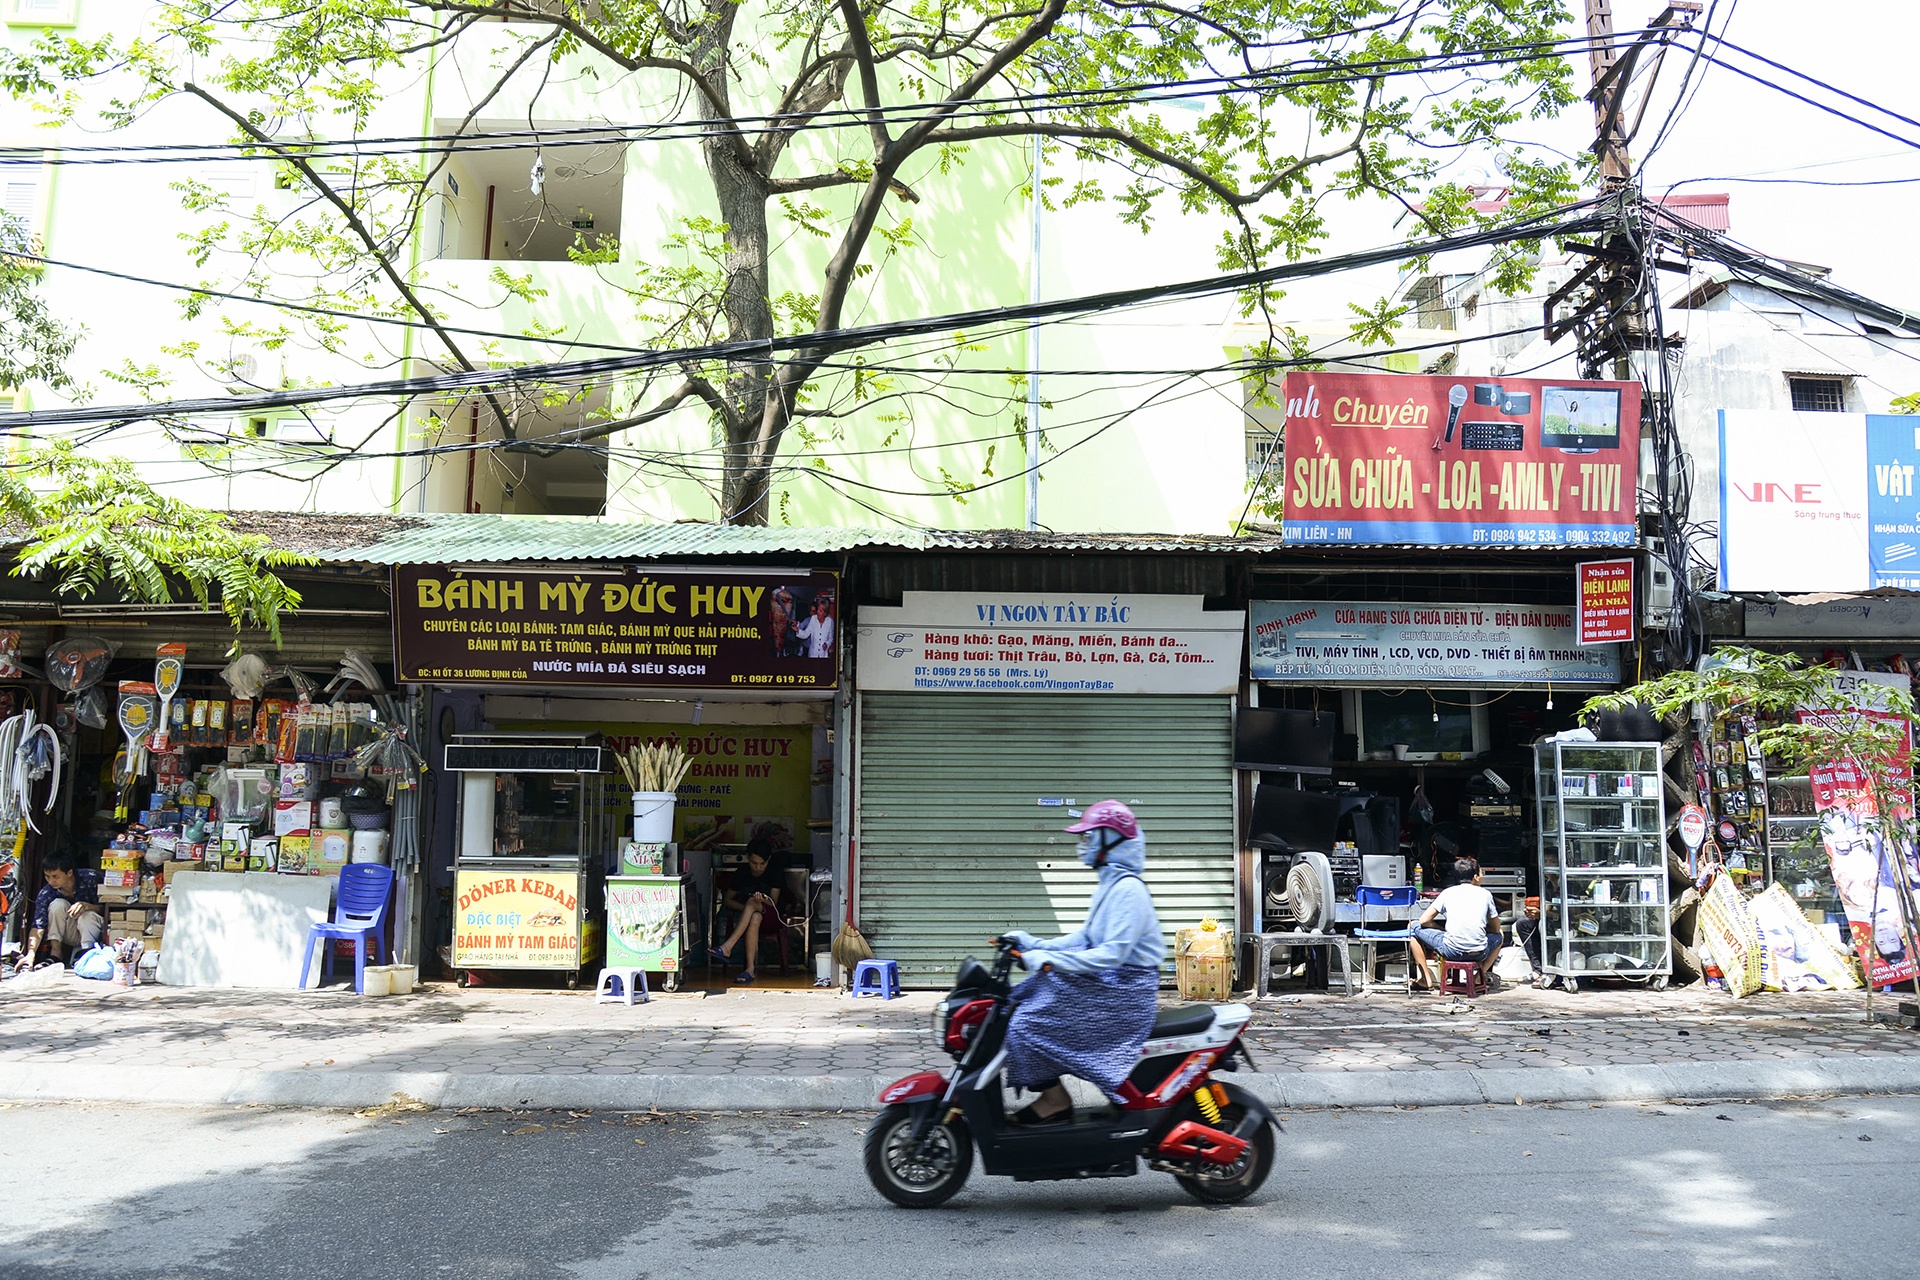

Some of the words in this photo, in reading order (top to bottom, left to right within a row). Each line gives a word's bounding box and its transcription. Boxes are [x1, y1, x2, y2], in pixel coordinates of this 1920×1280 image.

[1333, 396, 1428, 430] Chuyên
[1293, 436, 1342, 508] SỬA
[1350, 446, 1414, 509] CHỮA
[1438, 460, 1482, 510] LOA
[1875, 458, 1914, 503] VẬT
[1304, 525, 1328, 540] LIÊN
[1337, 527, 1352, 540] HN
[1473, 530, 1488, 541] ĐT:
[1491, 530, 1515, 542] 0984
[1517, 530, 1536, 542] 942
[1538, 530, 1556, 542] 534
[1566, 530, 1590, 542] 0904
[1592, 530, 1610, 543] 332
[1612, 531, 1631, 543] 492
[1874, 524, 1895, 535] NHẬN
[1898, 523, 1915, 533] SỬA
[1588, 568, 1609, 578] Nhận
[1612, 567, 1625, 576] sửa
[417, 572, 524, 613] BÁNH
[539, 576, 591, 615] MỲ
[601, 577, 677, 614] ĐỨC
[690, 585, 766, 618] HUY
[1583, 578, 1605, 596] ĐIỆN
[1606, 579, 1630, 595] LẠNH
[1584, 598, 1603, 608] TẠI
[1606, 596, 1628, 605] NHÀ
[976, 605, 995, 626] VỊ
[1000, 605, 1048, 622] NGON
[1053, 601, 1090, 623] TÂY
[1095, 596, 1131, 623] BẮC
[1359, 608, 1387, 624] HÀNG
[1444, 610, 1468, 628] ĐIỆN
[1470, 606, 1484, 625] TỬ
[1495, 610, 1518, 630] ĐIỆN
[1521, 611, 1542, 627] DÂN
[1545, 613, 1571, 630] DỤNG
[1617, 608, 1630, 618] LẠNH
[1829, 606, 1871, 619] ALCOREST
[423, 618, 467, 632] CHUYÊN
[470, 620, 493, 633] CÁC
[495, 621, 520, 636] LOẠI
[523, 620, 557, 634] BÁNH:
[560, 624, 584, 635] TAM
[587, 623, 617, 637] GIÁC,
[620, 623, 650, 637] BÁNH
[653, 624, 671, 637] MỲ
[673, 626, 695, 638] QUE
[698, 621, 717, 638] HẢI
[720, 626, 761, 640] PHÒNG,
[1256, 618, 1284, 635] ĐỊNH
[1285, 608, 1318, 626] HẠNH
[925, 633, 959, 645] Hàng
[964, 634, 993, 645] khô:
[997, 634, 1027, 647] Gạo,
[1032, 635, 1074, 647] Măng,
[1079, 634, 1117, 647] Miến,
[1121, 636, 1155, 647] Bánh
[1400, 630, 1432, 641] CHUYÊN
[1433, 632, 1452, 641] MUA
[1453, 630, 1471, 641] BÁN
[1613, 629, 1627, 638] LẠNH
[468, 637, 498, 651] BÁNH
[501, 638, 518, 651] MỲ
[521, 640, 536, 651] BA
[539, 638, 552, 652] TÊ
[555, 638, 592, 653] TRỨNG
[601, 641, 632, 654] BÁNH
[635, 642, 652, 655] MỲ
[655, 641, 691, 655] TRỨNG
[695, 644, 718, 658] THỊT
[1295, 647, 1319, 659] TIVI,
[1323, 644, 1348, 658] MÁY
[1353, 644, 1379, 658] TÍNH
[1390, 648, 1414, 660] LCD,
[1417, 648, 1443, 660] VCD,
[1447, 648, 1471, 659] DVD
[1481, 645, 1511, 660] THIẾT
[1514, 646, 1525, 663] BỊ
[1528, 646, 1546, 661] ÂM
[1549, 650, 1585, 661] THANH
[924, 650, 959, 661] Hàng
[963, 650, 993, 661] tươi:
[998, 650, 1023, 663] Thịt
[1027, 651, 1060, 663] Trâu,
[1065, 651, 1087, 663] Bò,
[1091, 651, 1118, 664] Lợn,
[1123, 652, 1145, 664] Gà,
[1149, 652, 1170, 664] Cá,
[418, 668, 431, 677] ĐC:
[433, 669, 441, 677] KI
[442, 667, 452, 677] ỐT
[454, 669, 463, 677] 36
[465, 669, 490, 678] LƯƠNG
[491, 669, 510, 679] ĐỊNH
[512, 668, 527, 678] CỦA
[532, 659, 572, 672] NƯỚC
[576, 661, 604, 673] MÍA
[607, 661, 626, 674] ĐÁ
[631, 661, 664, 674] SIÊU
[667, 664, 706, 677] SẠCH
[914, 667, 930, 676] ĐT:
[932, 667, 956, 676] 0969
[959, 668, 971, 676] 29
[974, 668, 986, 676] 56
[988, 668, 1001, 676] 56
[1006, 668, 1031, 678] (Mrs.
[1034, 668, 1049, 678] Lý)
[1275, 659, 1294, 674] BẾP
[1336, 663, 1358, 675] CƠM
[1404, 665, 1415, 675] VI
[731, 675, 746, 683] ĐT:
[749, 675, 773, 683] 0987
[776, 675, 795, 683] 619
[914, 677, 1114, 690] https://www.facebook.com/VingonTayBac
[687, 732, 738, 756] ĐỨC
[743, 737, 793, 757] HUY
[691, 761, 739, 777] BÁNH
[745, 762, 772, 777] MỲ
[709, 784, 731, 794] PATÊ
[691, 798, 721, 808] PHÒNG
[521, 878, 577, 911] KEBAB
[466, 911, 492, 929] ĐẶC
[496, 911, 521, 929] BIỆT
[457, 933, 491, 948] BÁNH
[495, 933, 514, 948] MỲ
[518, 935, 544, 948] TAM
[548, 933, 577, 949] GIÁC
